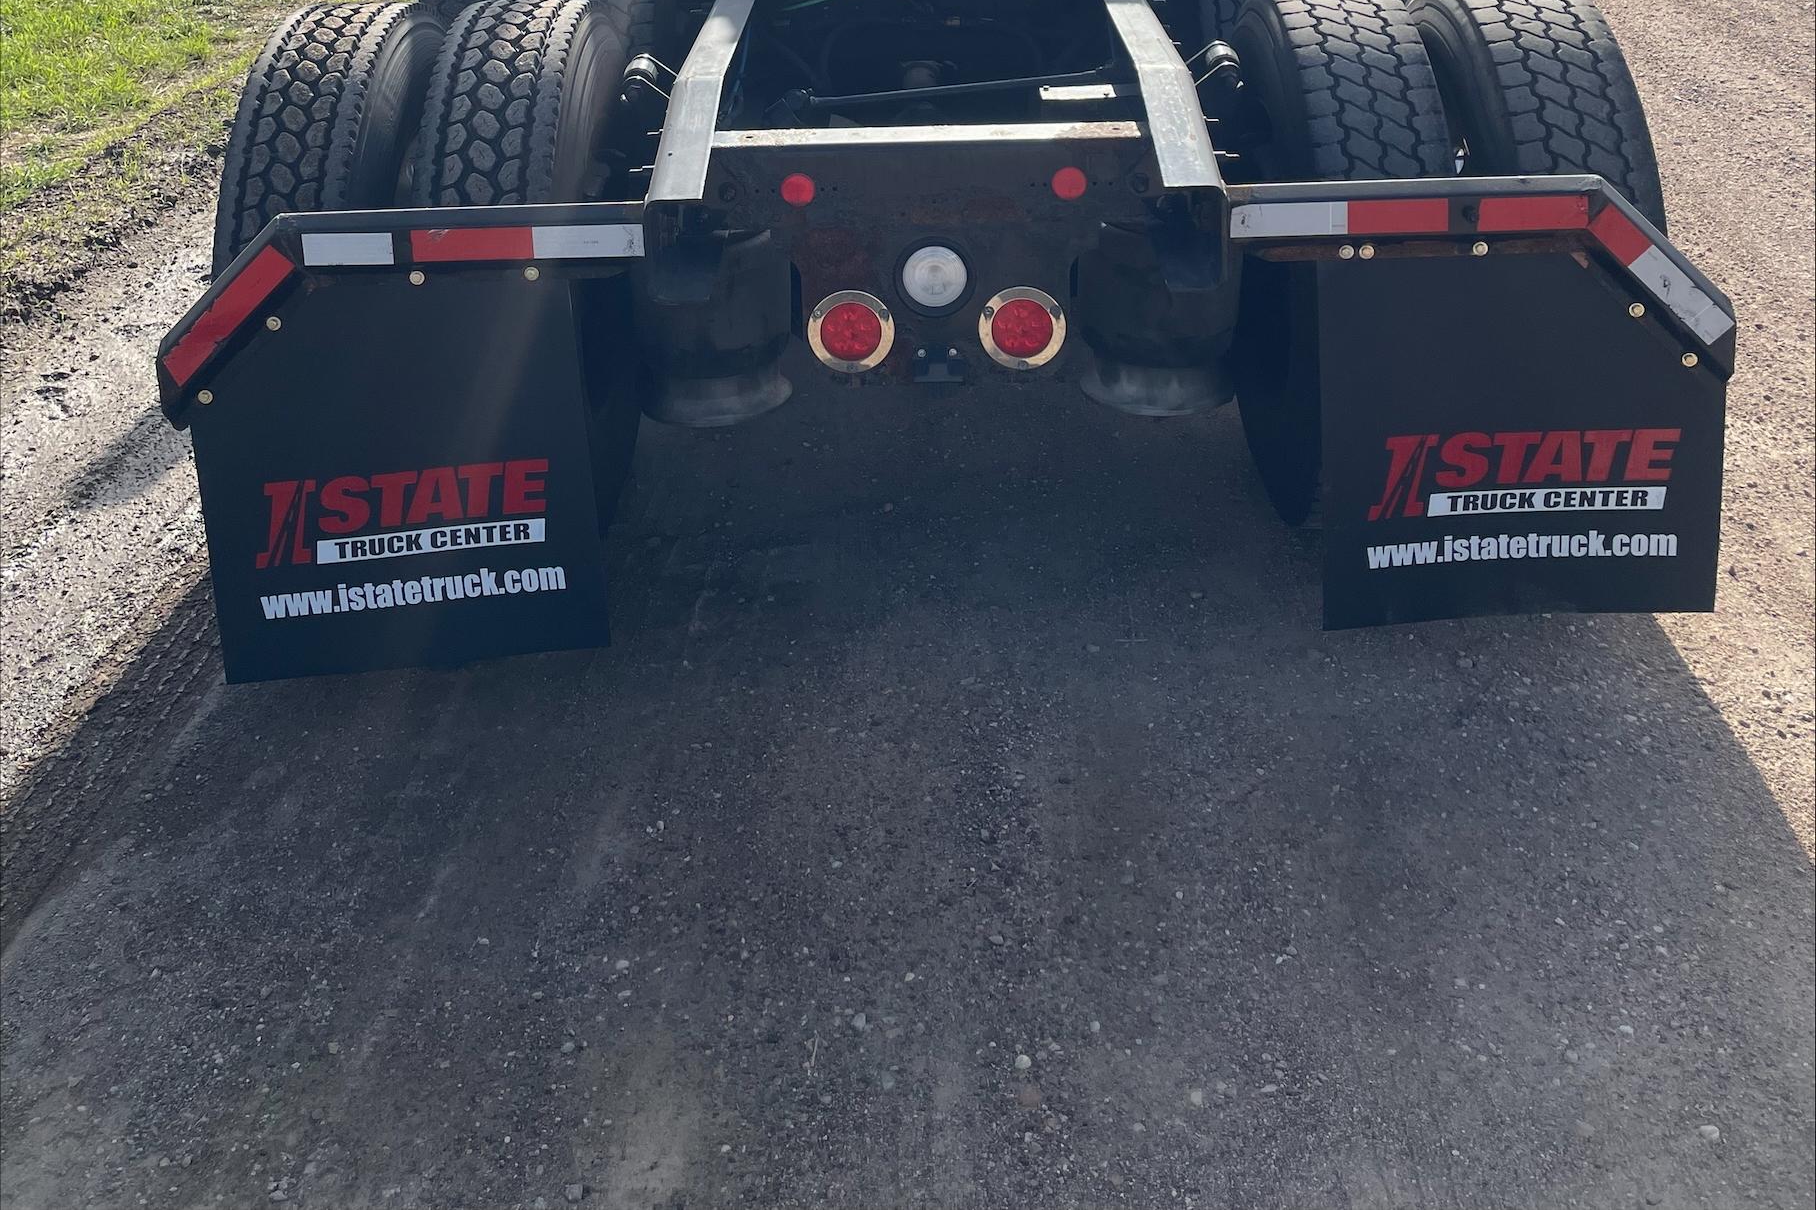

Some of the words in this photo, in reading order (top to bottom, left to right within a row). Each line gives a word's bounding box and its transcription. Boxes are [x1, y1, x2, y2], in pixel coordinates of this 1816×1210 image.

[1446, 491, 1536, 512] TRUCK
[1543, 489, 1649, 509] CENTER
[334, 533, 422, 559] TRUCK
[430, 522, 531, 549] CENTER
[1367, 529, 1678, 569] www.istatetruck.com
[259, 565, 567, 620] www.istatetruck.com
